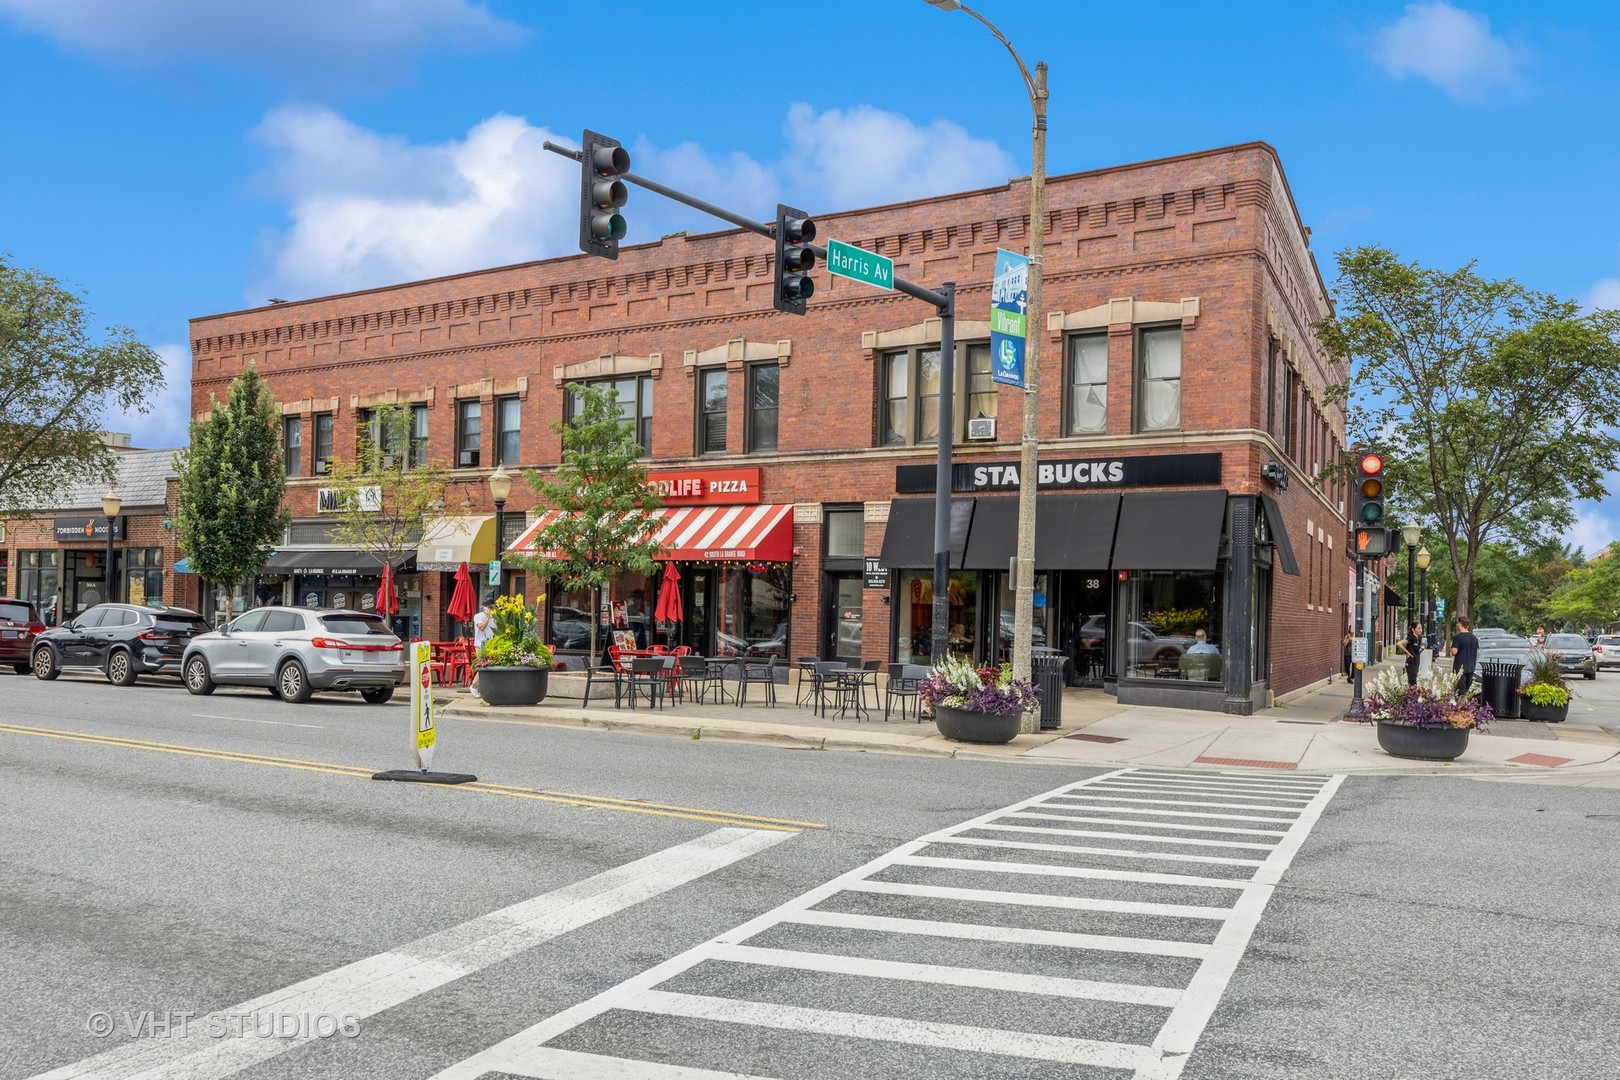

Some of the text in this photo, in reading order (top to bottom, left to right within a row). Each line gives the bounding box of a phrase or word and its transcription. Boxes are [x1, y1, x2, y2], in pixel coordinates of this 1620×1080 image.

[832, 248, 889, 281] Harris Av
[997, 310, 1020, 335] Vibrant
[974, 461, 1124, 486] STABUCKS
[709, 480, 748, 493] PIZZA
[1086, 579, 1100, 589] 38
